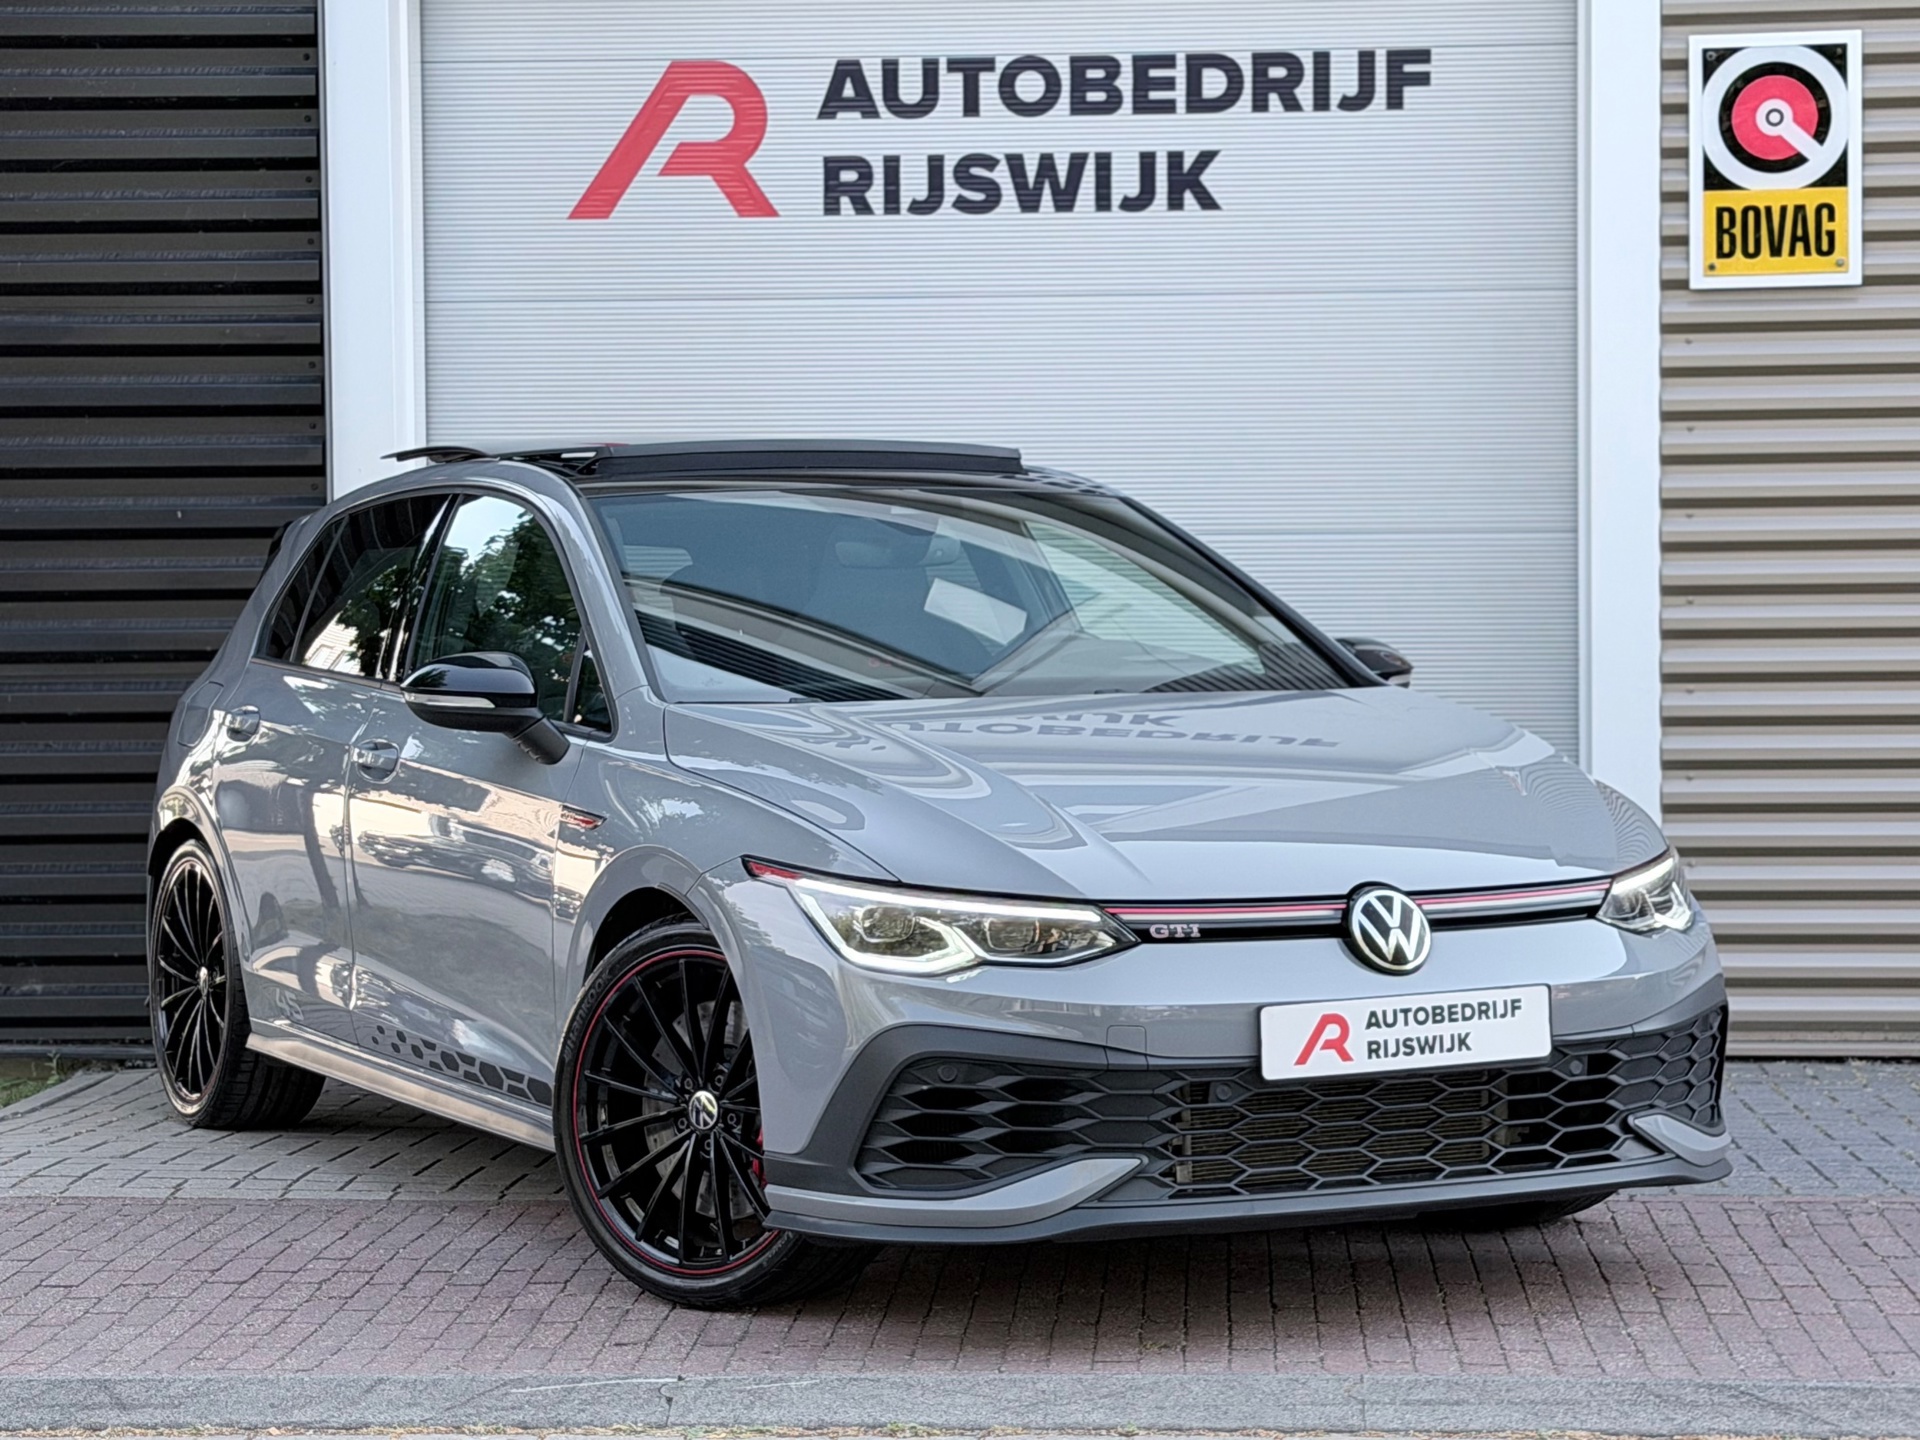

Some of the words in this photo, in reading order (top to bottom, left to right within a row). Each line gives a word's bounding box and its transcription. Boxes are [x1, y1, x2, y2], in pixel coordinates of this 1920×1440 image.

[817, 48, 1433, 119] AUTOBEDRIJF
[822, 150, 1223, 216] RIJSWIJK
[1715, 203, 1836, 260] BOVAG
[1149, 923, 1202, 939] GTI
[1364, 998, 1522, 1030] AUTOBEDRIJF
[1366, 1031, 1472, 1060] RIJSWIJK
